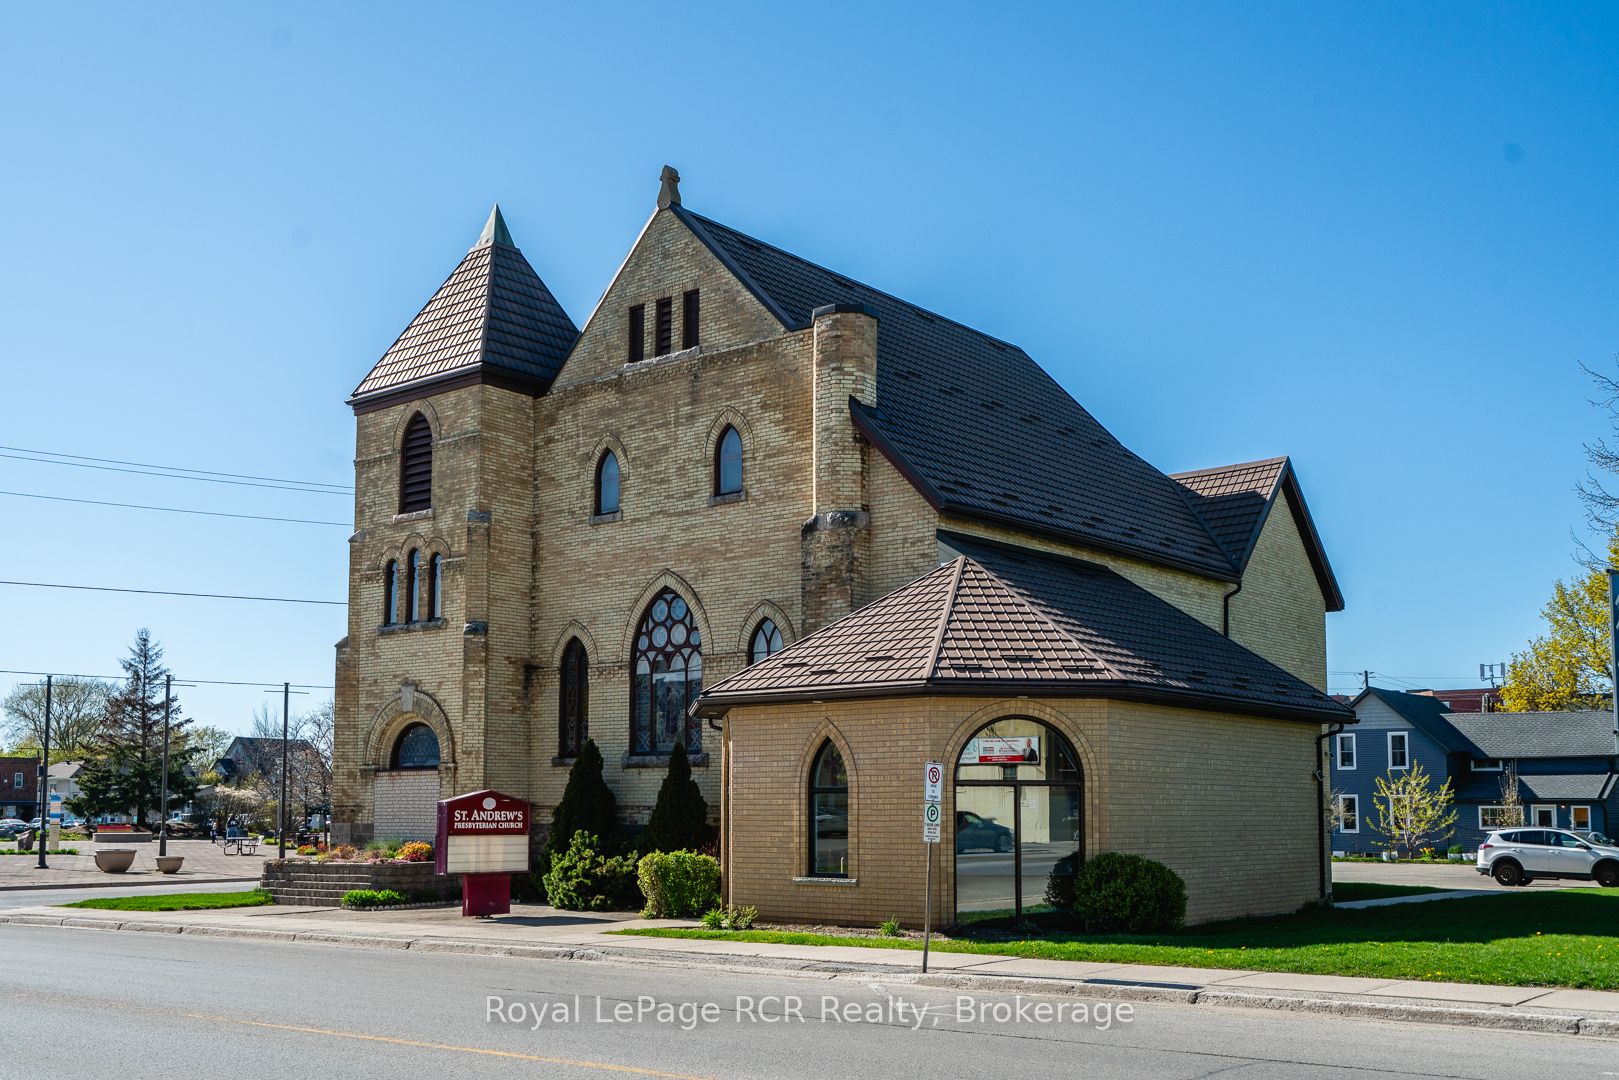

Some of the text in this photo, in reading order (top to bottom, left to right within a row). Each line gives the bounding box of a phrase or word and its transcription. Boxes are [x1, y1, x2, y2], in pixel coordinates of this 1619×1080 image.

[454, 809, 523, 821] ST. ANDREW'S
[930, 809, 936, 818] P
